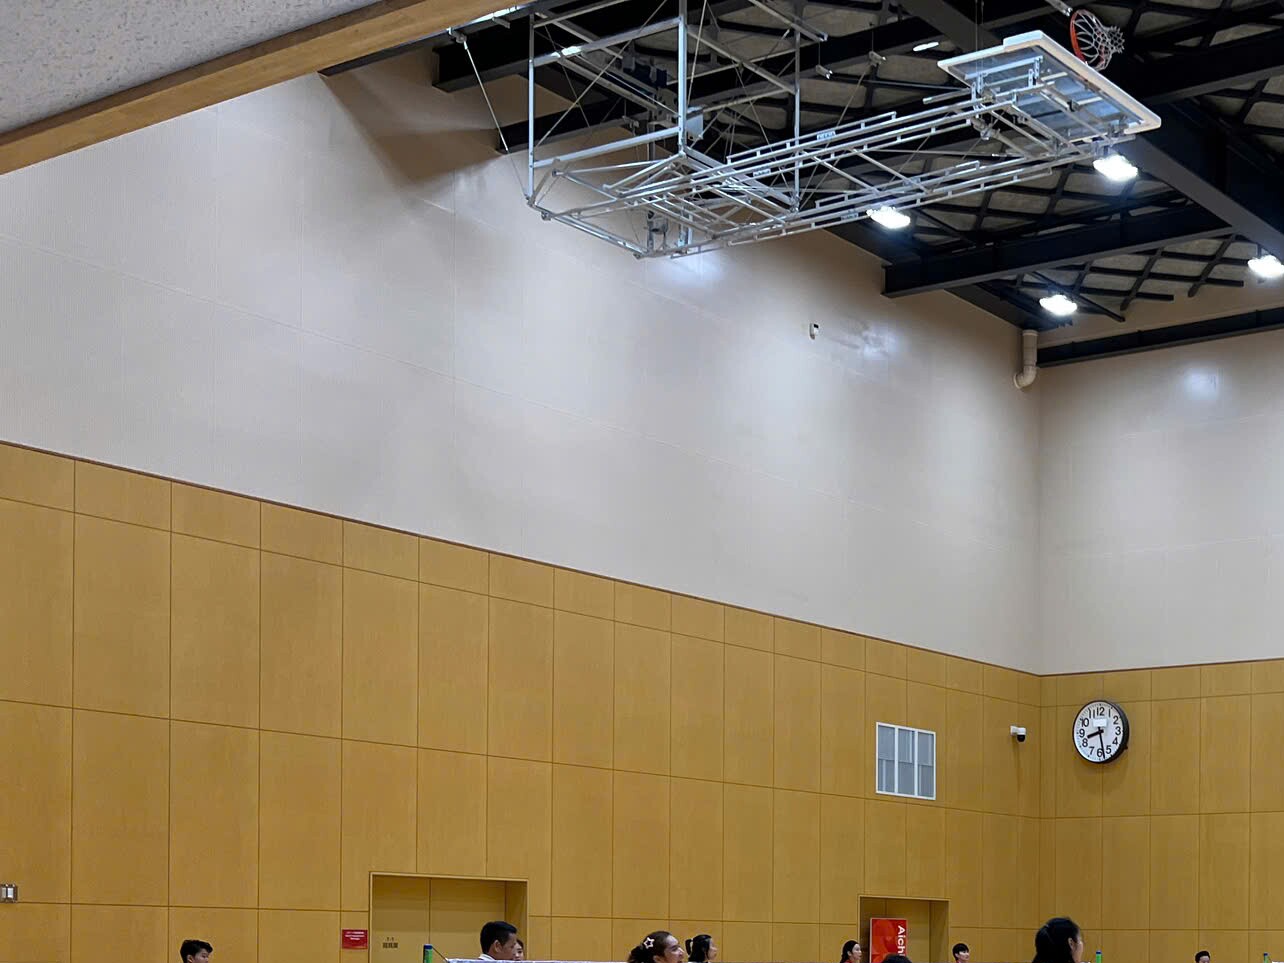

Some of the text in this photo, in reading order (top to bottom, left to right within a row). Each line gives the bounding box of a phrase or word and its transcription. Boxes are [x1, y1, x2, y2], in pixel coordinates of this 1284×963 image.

[1089, 708, 1096, 719] 11
[1096, 706, 1105, 716] 12
[1081, 718, 1090, 727] 10
[1113, 716, 1119, 725] 2
[1079, 728, 1085, 738] 9
[1115, 726, 1121, 736] 3
[1082, 739, 1088, 748] 8
[1112, 737, 1118, 746] 4
[1088, 746, 1095, 755] 7
[1096, 748, 1103, 757] 6
[1105, 745, 1112, 755] 5
